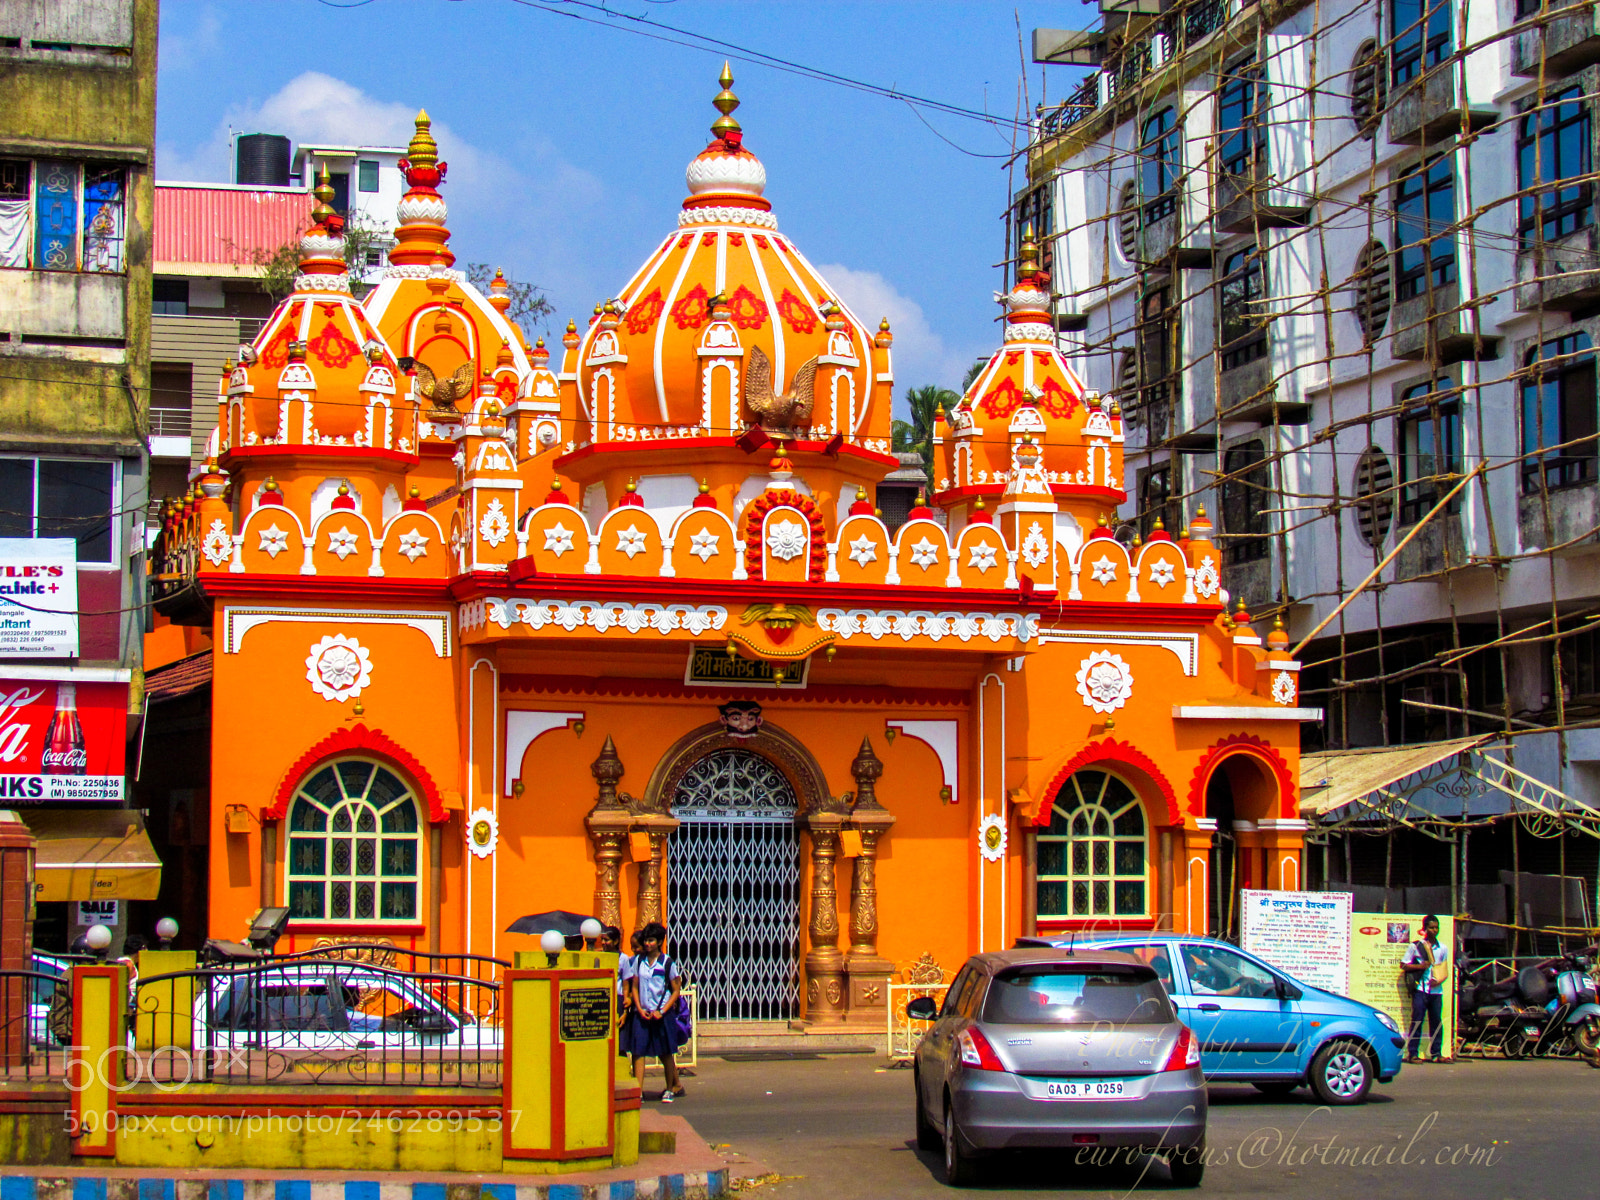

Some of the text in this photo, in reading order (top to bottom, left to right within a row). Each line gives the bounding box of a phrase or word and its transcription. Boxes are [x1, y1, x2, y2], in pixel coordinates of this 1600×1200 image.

[51, 779, 119, 787] Ph.No: 2250436
[51, 788, 119, 798] (M) 9850257959
[80, 901, 116, 913] SALE
[1048, 1083, 1123, 1094] GA03 P 0259
